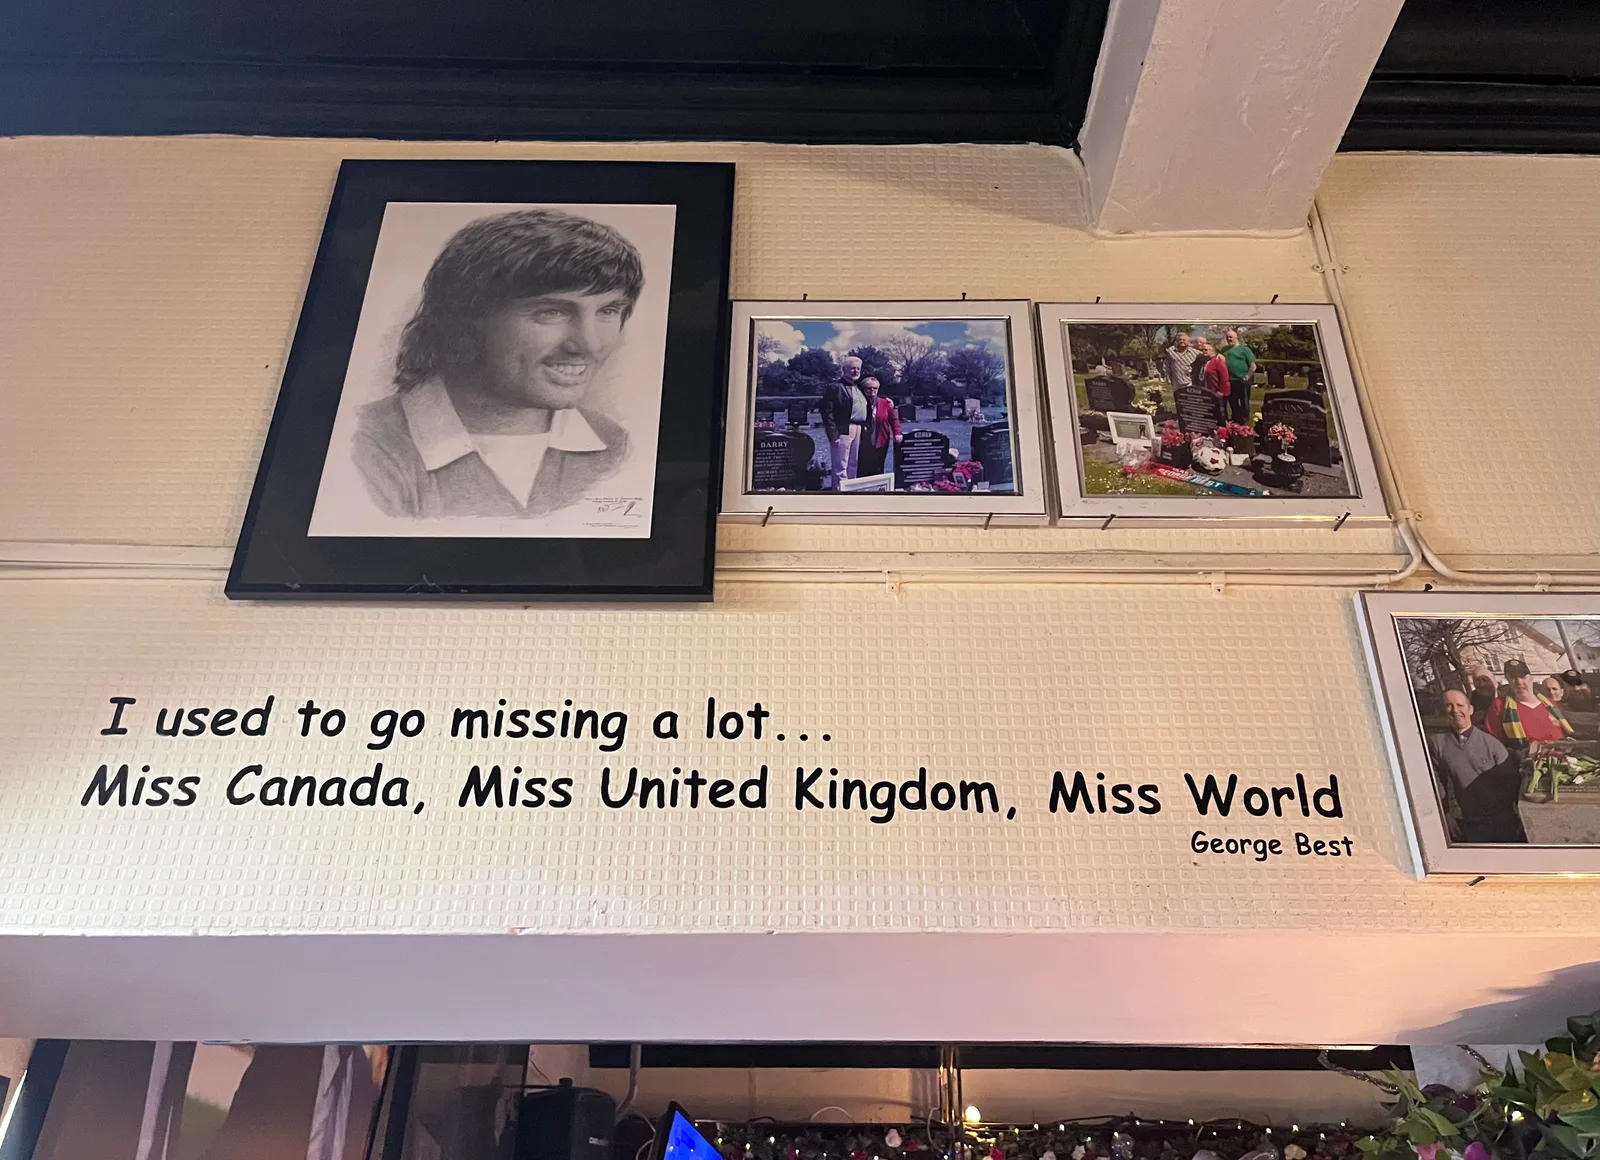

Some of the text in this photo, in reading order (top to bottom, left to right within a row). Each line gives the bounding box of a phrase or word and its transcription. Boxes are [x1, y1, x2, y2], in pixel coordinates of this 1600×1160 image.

[760, 441, 788, 449] BARRY
[101, 694, 832, 751] I used to go missing a lot...
[81, 762, 1343, 823] Miss Canada, Miss United Kingdom, Miss World
[1191, 831, 1354, 861] George Best
